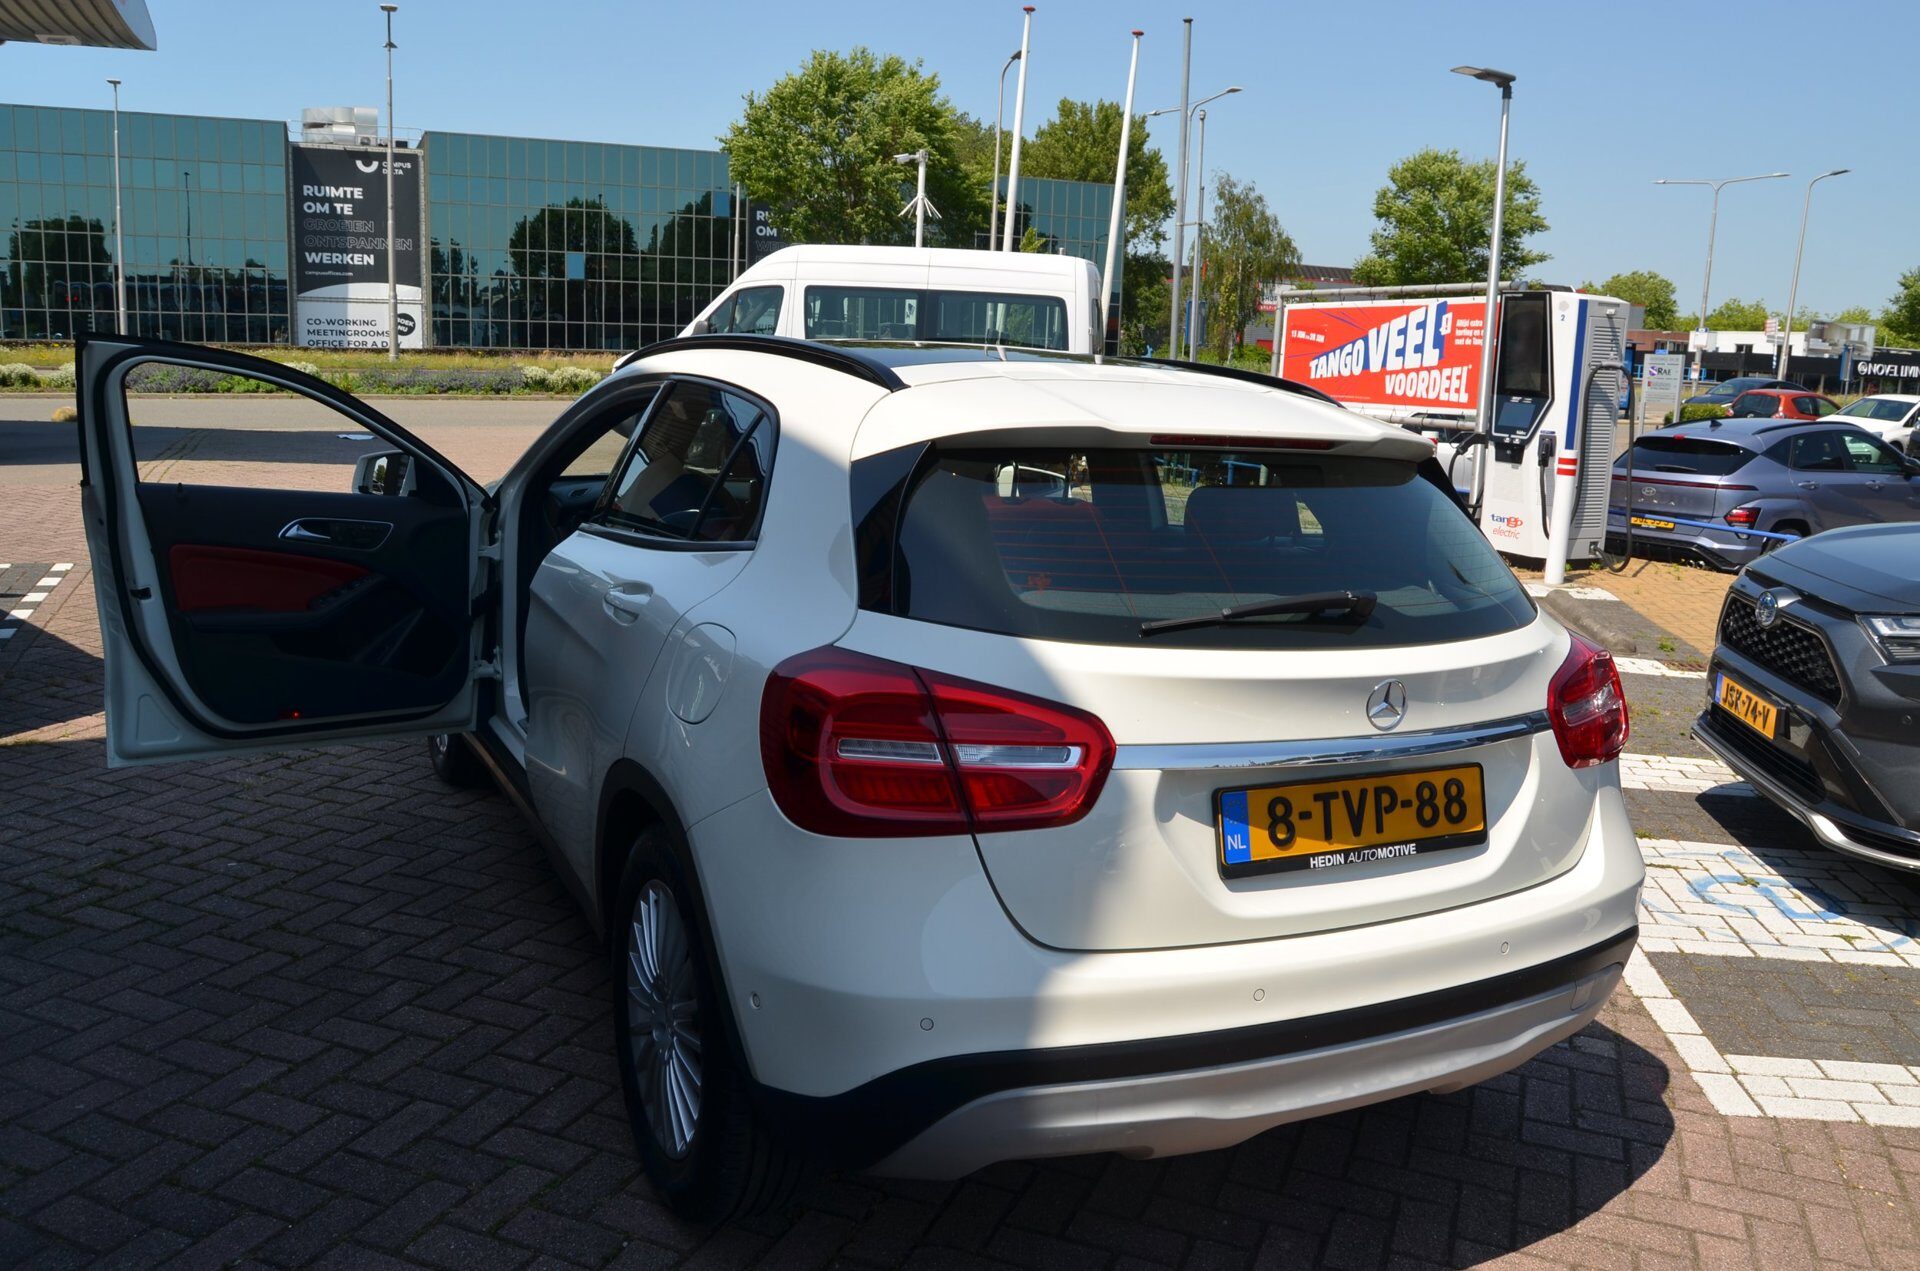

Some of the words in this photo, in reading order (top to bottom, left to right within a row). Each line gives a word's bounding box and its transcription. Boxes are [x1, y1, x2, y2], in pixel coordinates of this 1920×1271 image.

[303, 184, 364, 199] RUIMTE
[303, 201, 330, 214] OM
[333, 202, 354, 216] TE
[303, 217, 375, 233] GROEIEN
[304, 251, 375, 266] WERKEN
[306, 317, 377, 327] CO-WORKING
[306, 328, 390, 338] MEETINGROOMS
[307, 339, 344, 348] OFFICE
[347, 340, 368, 348] FOR
[371, 340, 379, 348] A
[1309, 339, 1364, 379] TANGO
[1868, 362, 1898, 377] NOVEL
[1491, 513, 1523, 528] tango
[1492, 526, 1521, 540] electric
[1227, 834, 1247, 850] NL
[1267, 777, 1468, 848] 8-TVP-88
[1309, 853, 1345, 869] HEDIN
[1347, 843, 1417, 864] AUTOMOTIVE
